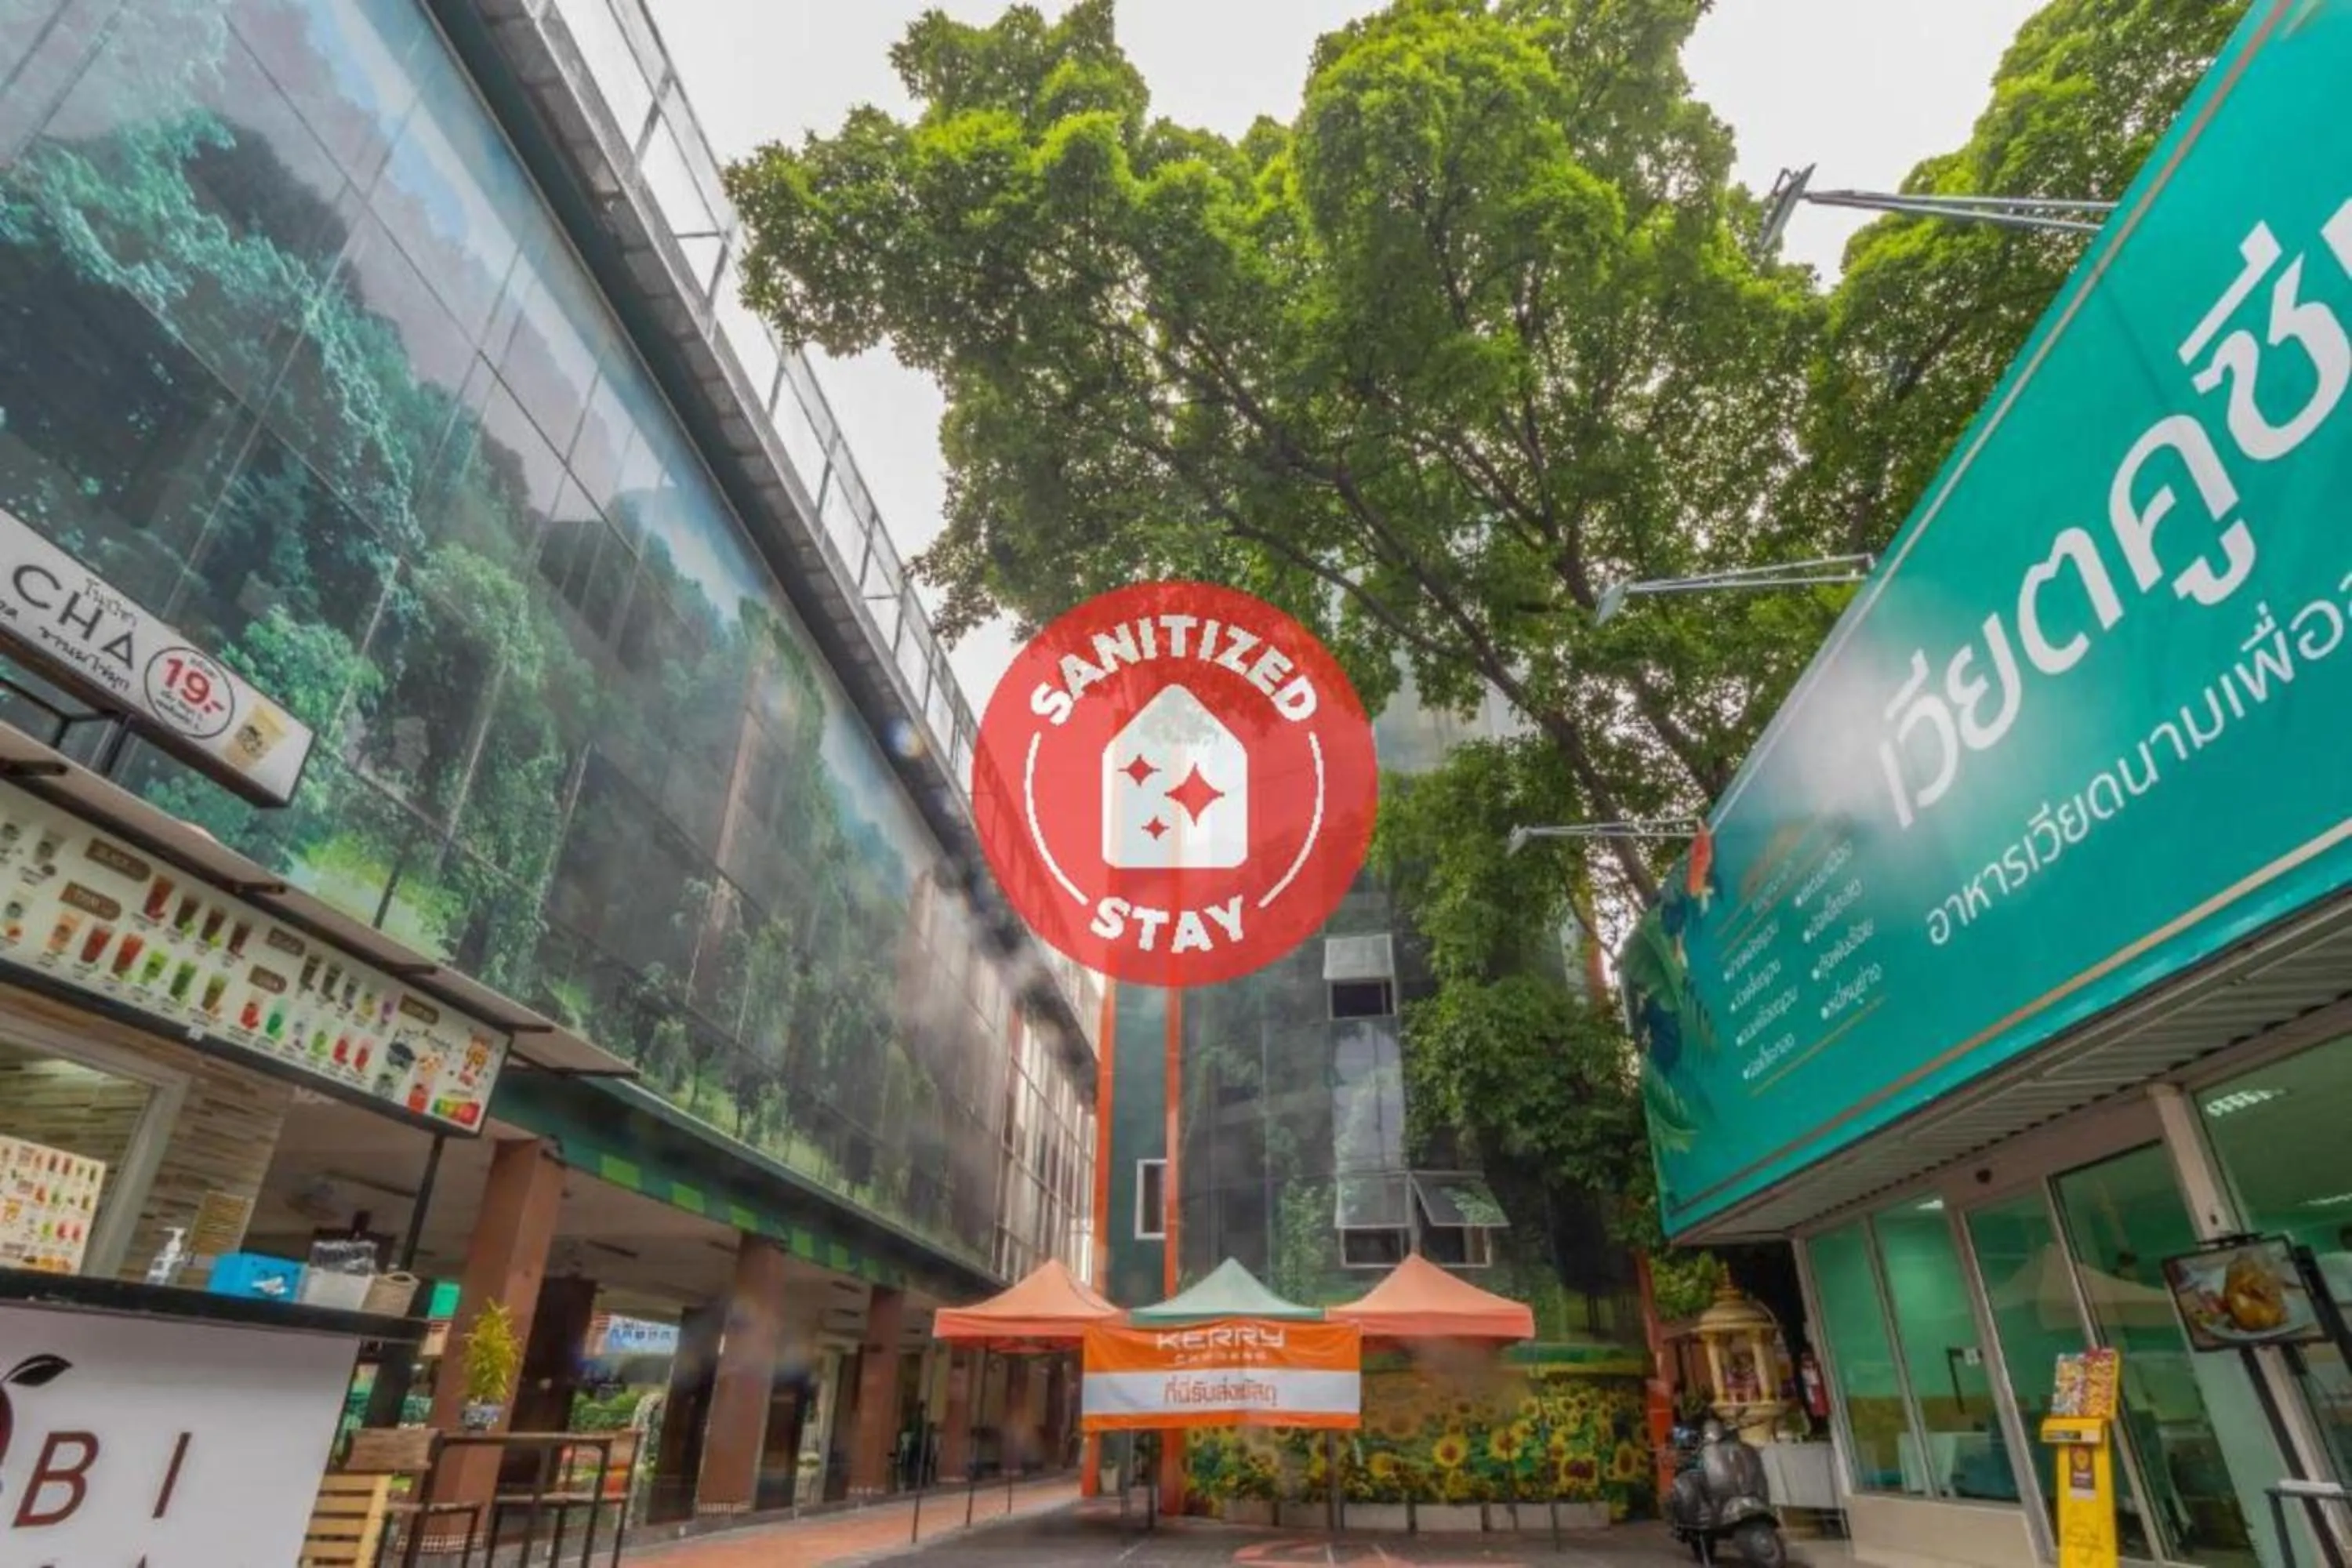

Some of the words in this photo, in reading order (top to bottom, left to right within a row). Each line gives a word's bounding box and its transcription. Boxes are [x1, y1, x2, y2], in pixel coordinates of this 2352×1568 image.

[13, 564, 134, 670] CHA
[1879, 198, 2352, 828] เวียตคูซี
[1926, 572, 2352, 945] อาหารเวียดนามเพื่อ
[1156, 1327, 1286, 1351] KERRY
